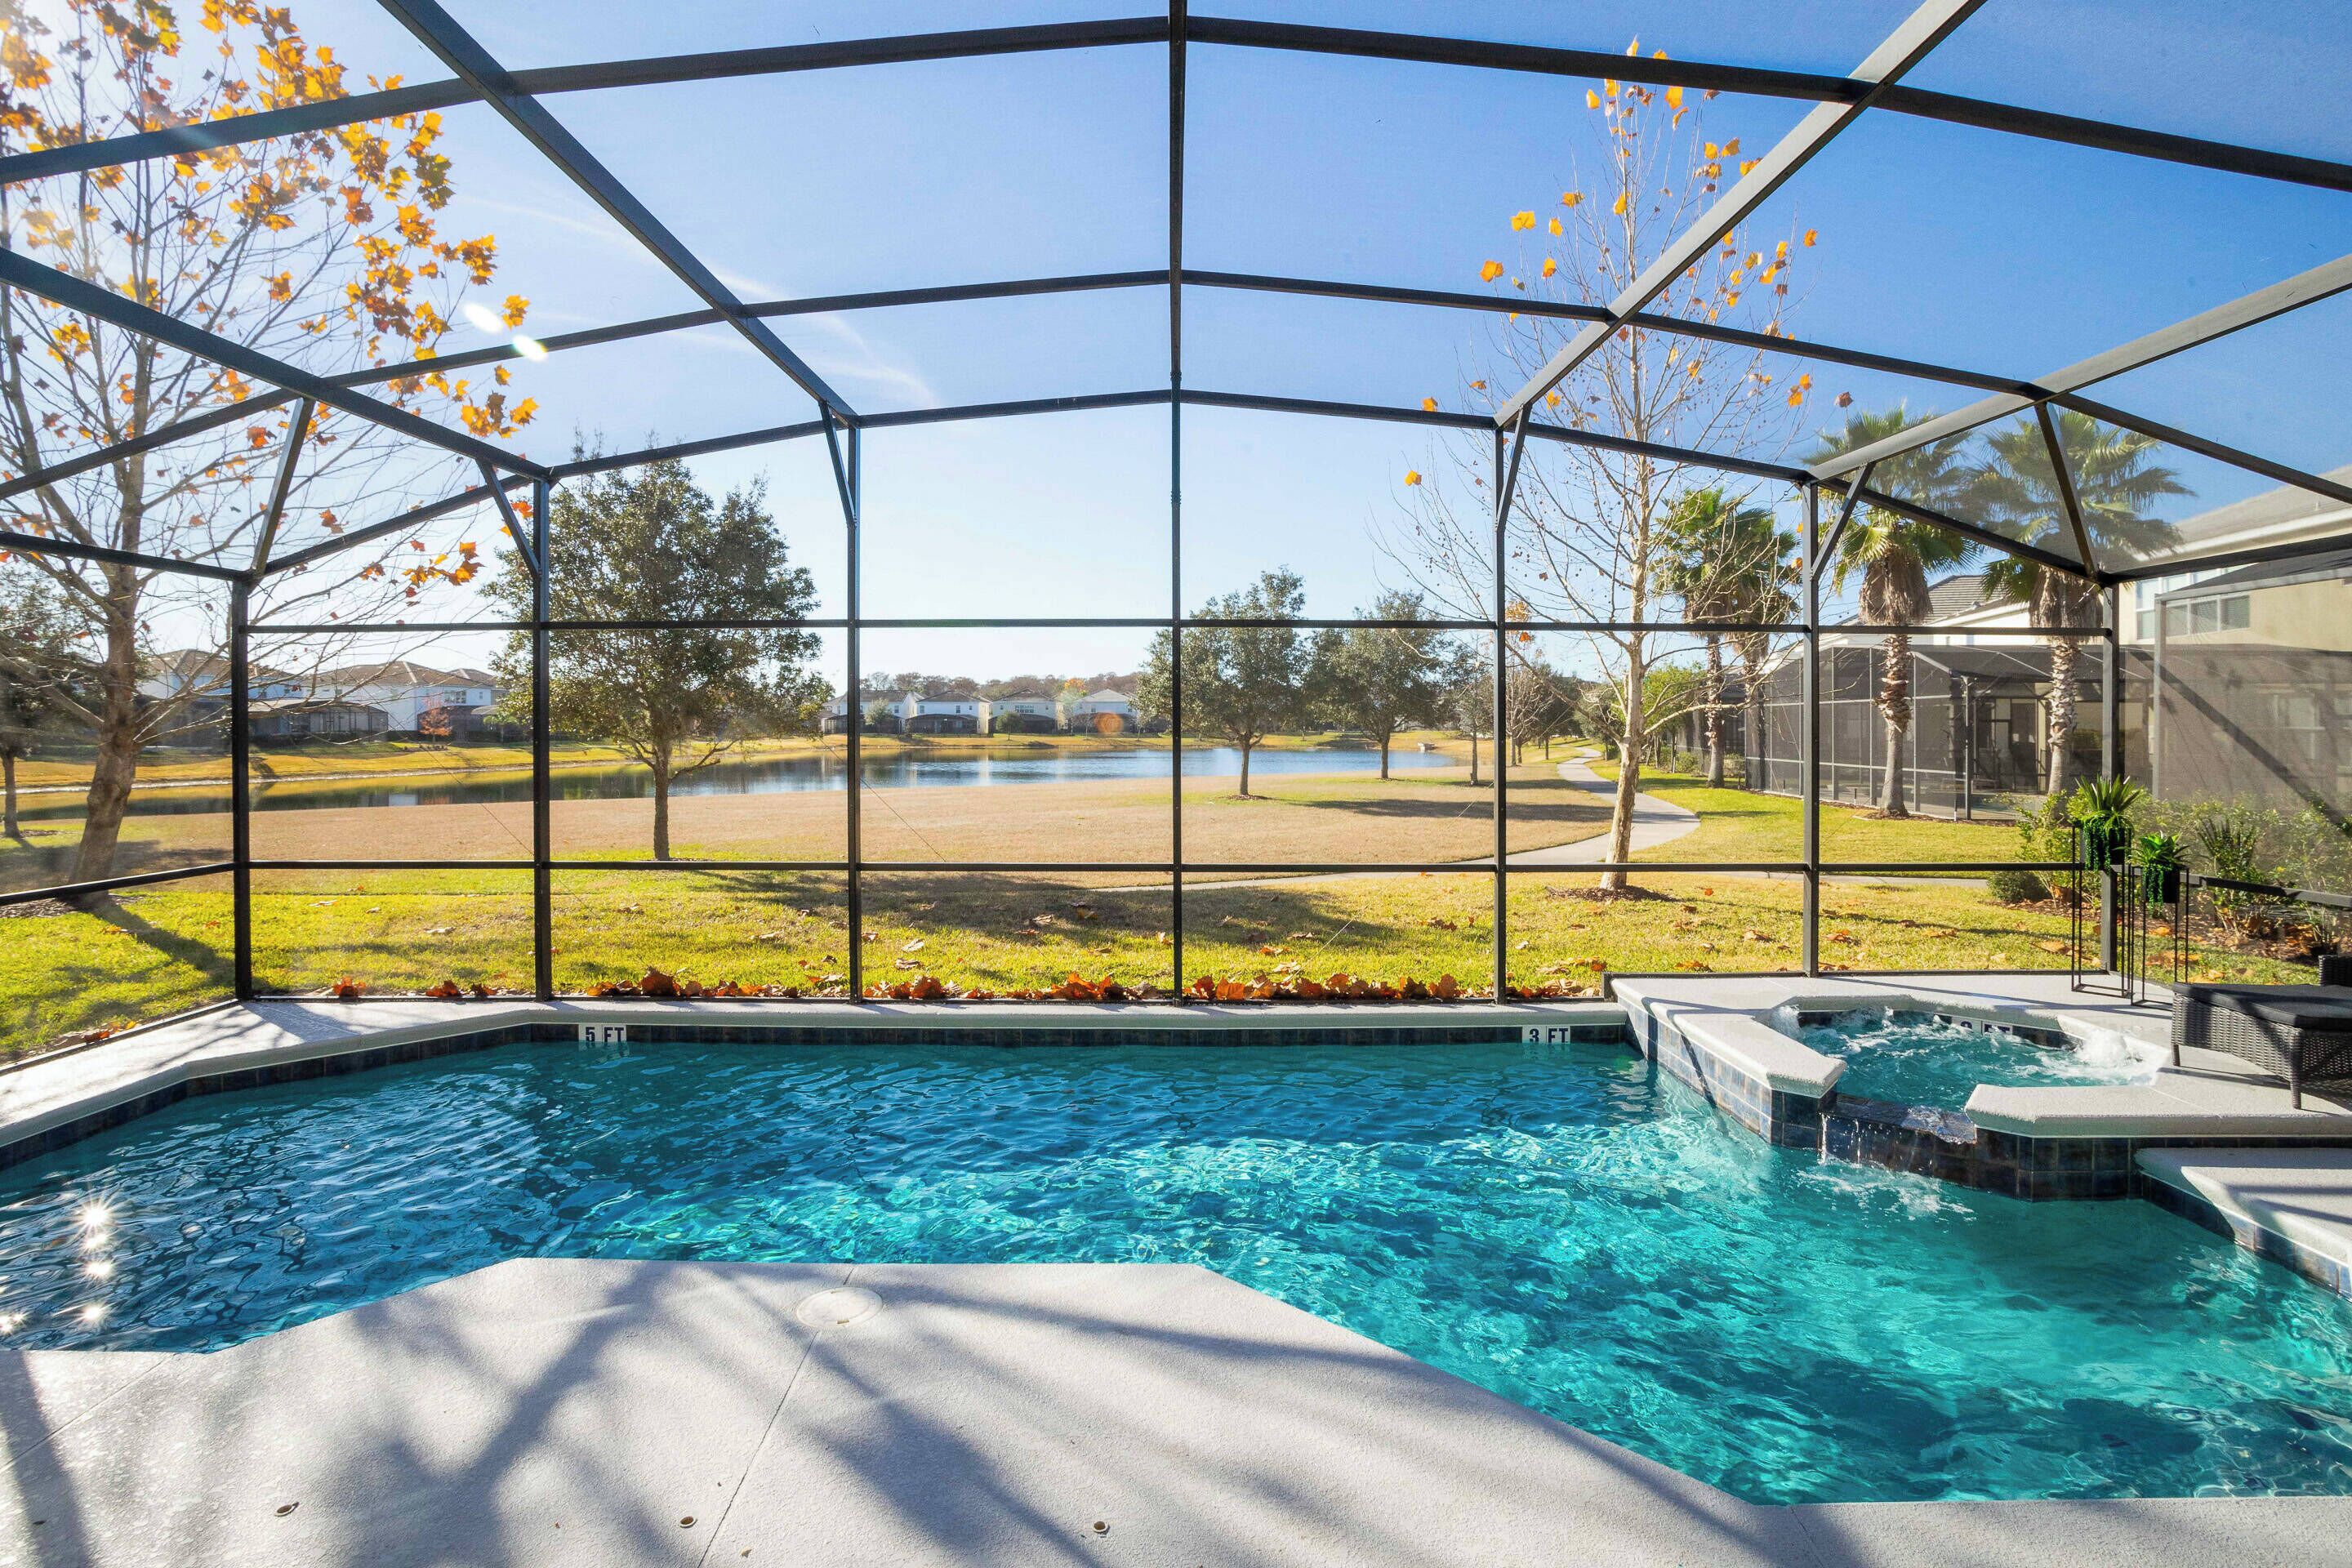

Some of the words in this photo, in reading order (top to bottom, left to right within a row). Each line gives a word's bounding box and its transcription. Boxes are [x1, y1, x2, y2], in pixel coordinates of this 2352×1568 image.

[586, 1027, 595, 1041] 5
[604, 1027, 624, 1042] FT
[1529, 1028, 1539, 1042] 3
